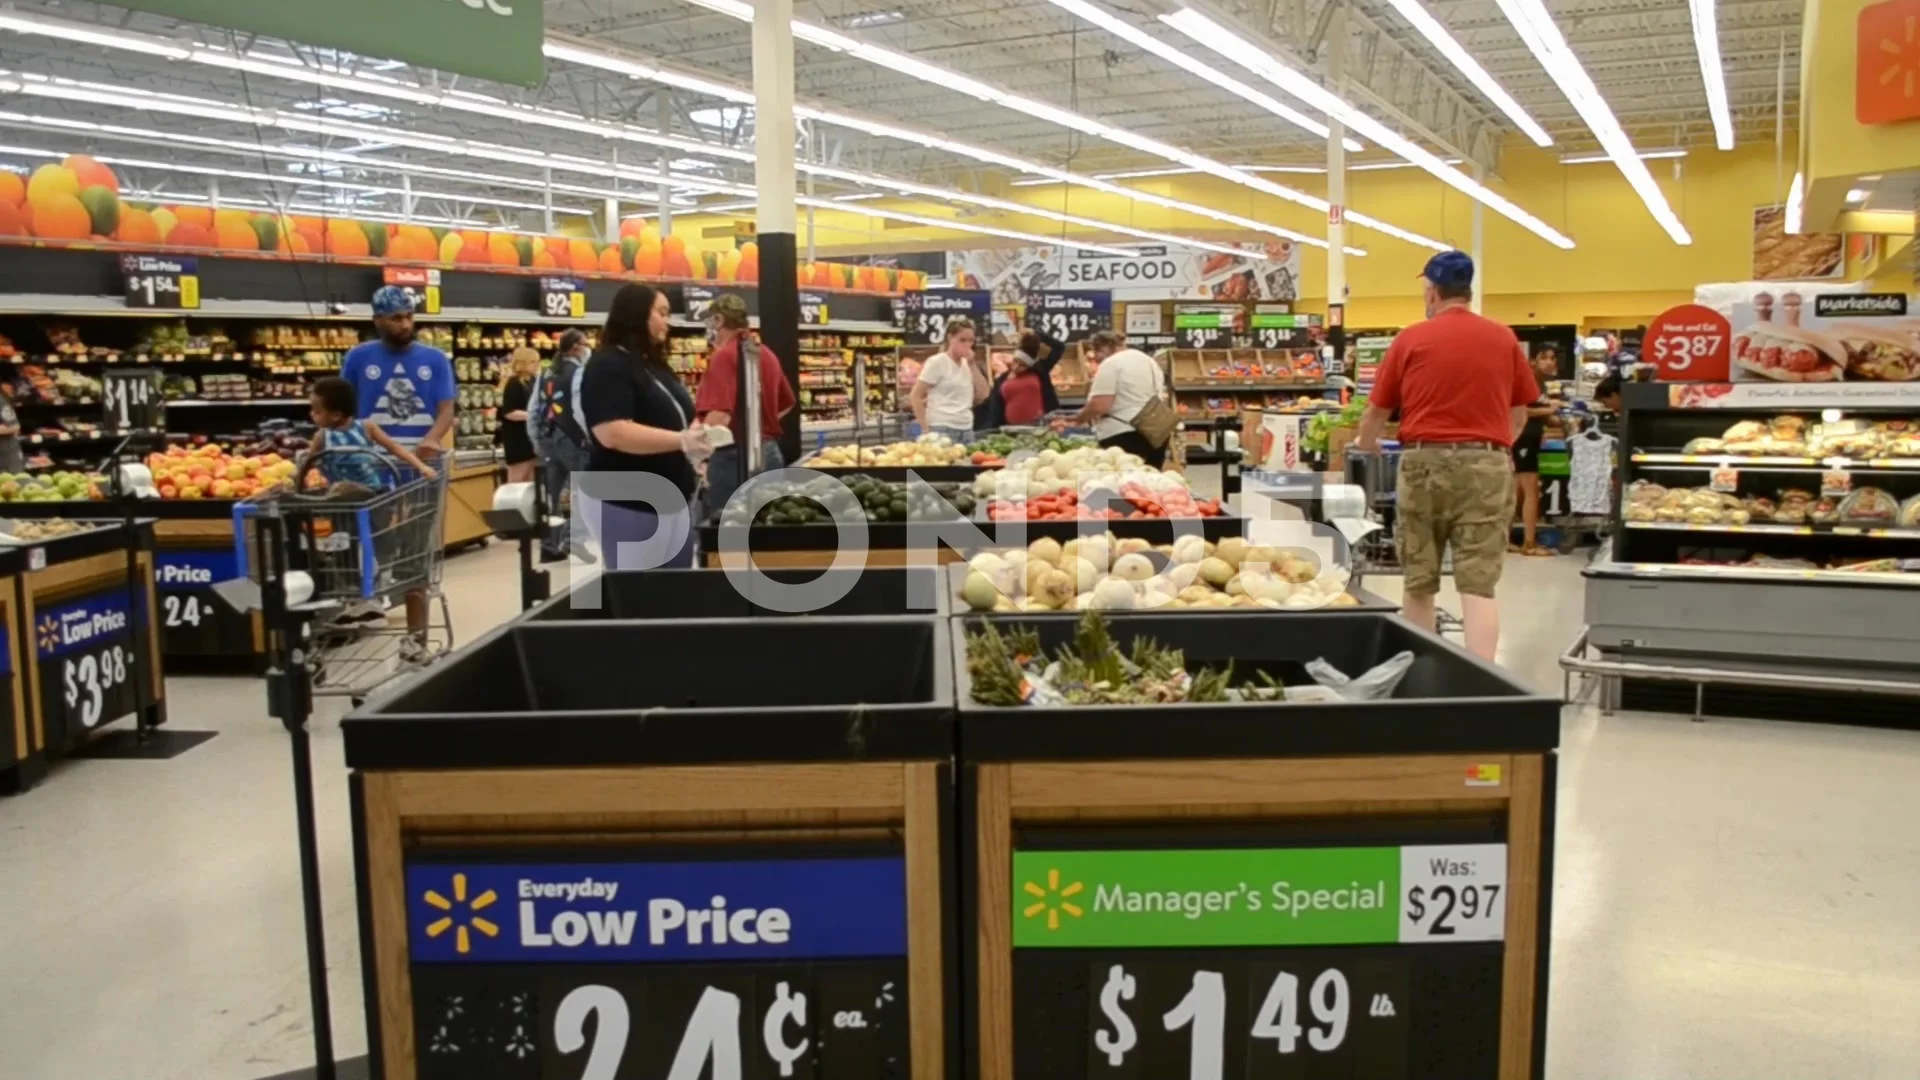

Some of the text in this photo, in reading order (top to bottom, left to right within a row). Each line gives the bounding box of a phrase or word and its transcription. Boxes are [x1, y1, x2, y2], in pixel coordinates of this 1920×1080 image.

[1068, 261, 1176, 282] SEAFOOD
[163, 564, 212, 582] Price
[62, 609, 126, 645] Low Price
[1429, 858, 1477, 877] Was:
[518, 878, 618, 901] Everyday
[1093, 880, 1385, 920] Manager's Special
[519, 894, 791, 947] Low Price
